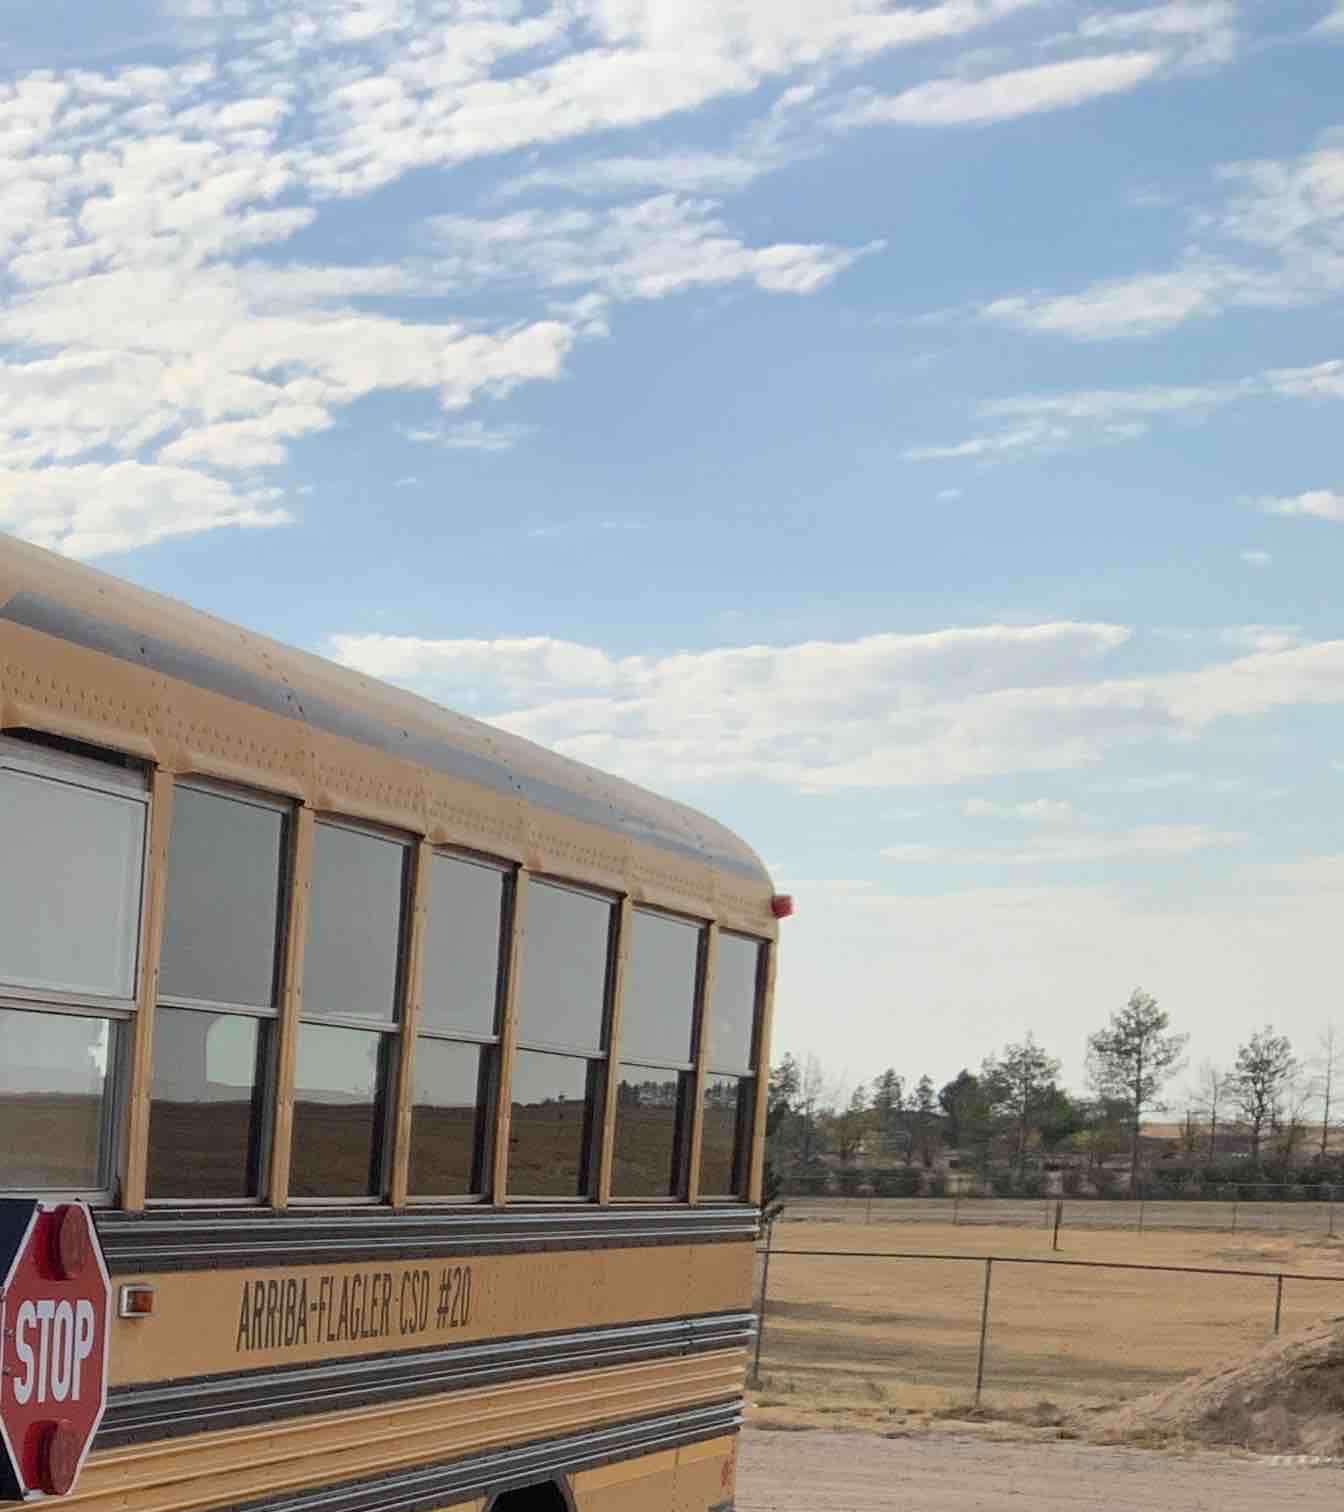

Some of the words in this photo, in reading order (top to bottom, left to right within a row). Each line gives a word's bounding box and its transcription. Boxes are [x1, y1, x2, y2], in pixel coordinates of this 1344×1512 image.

[13, 1299, 95, 1405] STOP
[237, 1271, 393, 1352] ARRIBA-FLAGLER
[400, 1269, 430, 1335] CSD
[437, 1266, 472, 1329] #20
